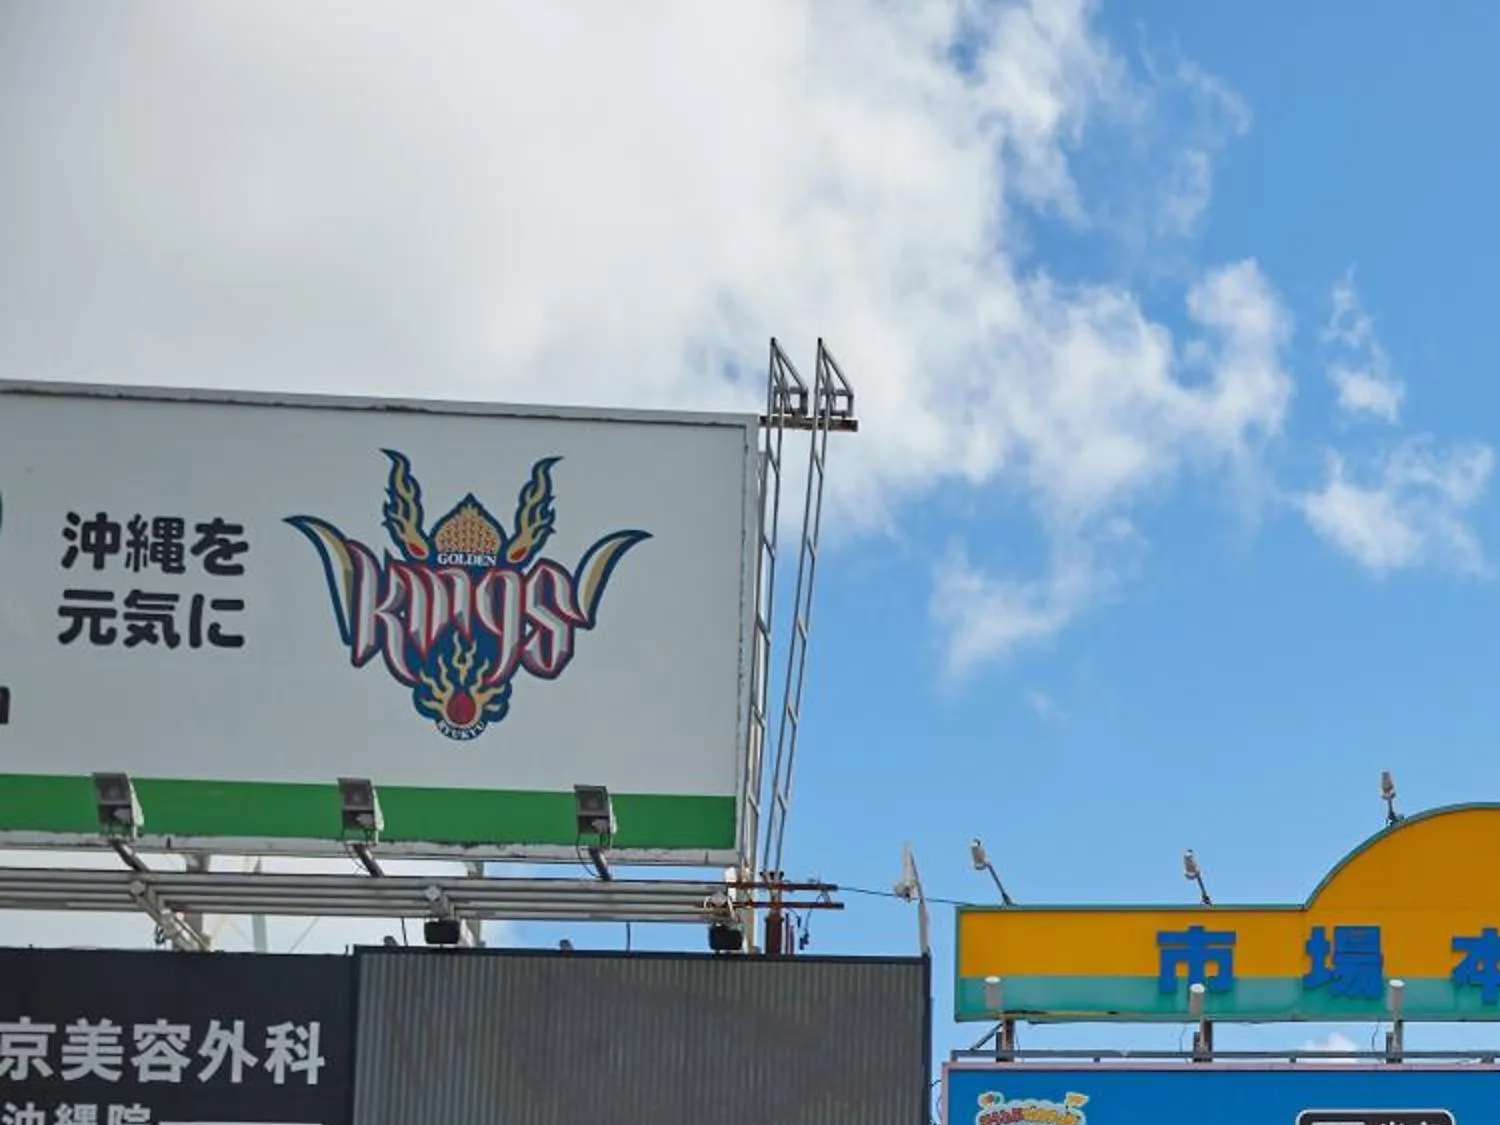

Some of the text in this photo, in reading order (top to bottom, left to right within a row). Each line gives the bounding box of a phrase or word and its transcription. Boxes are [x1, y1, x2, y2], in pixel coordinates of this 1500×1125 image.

[61, 511, 249, 576] 沖縄を
[437, 553, 497, 567] GOLDEN
[57, 588, 245, 650] 元気に
[0, 1016, 326, 1085] 京美容外科
